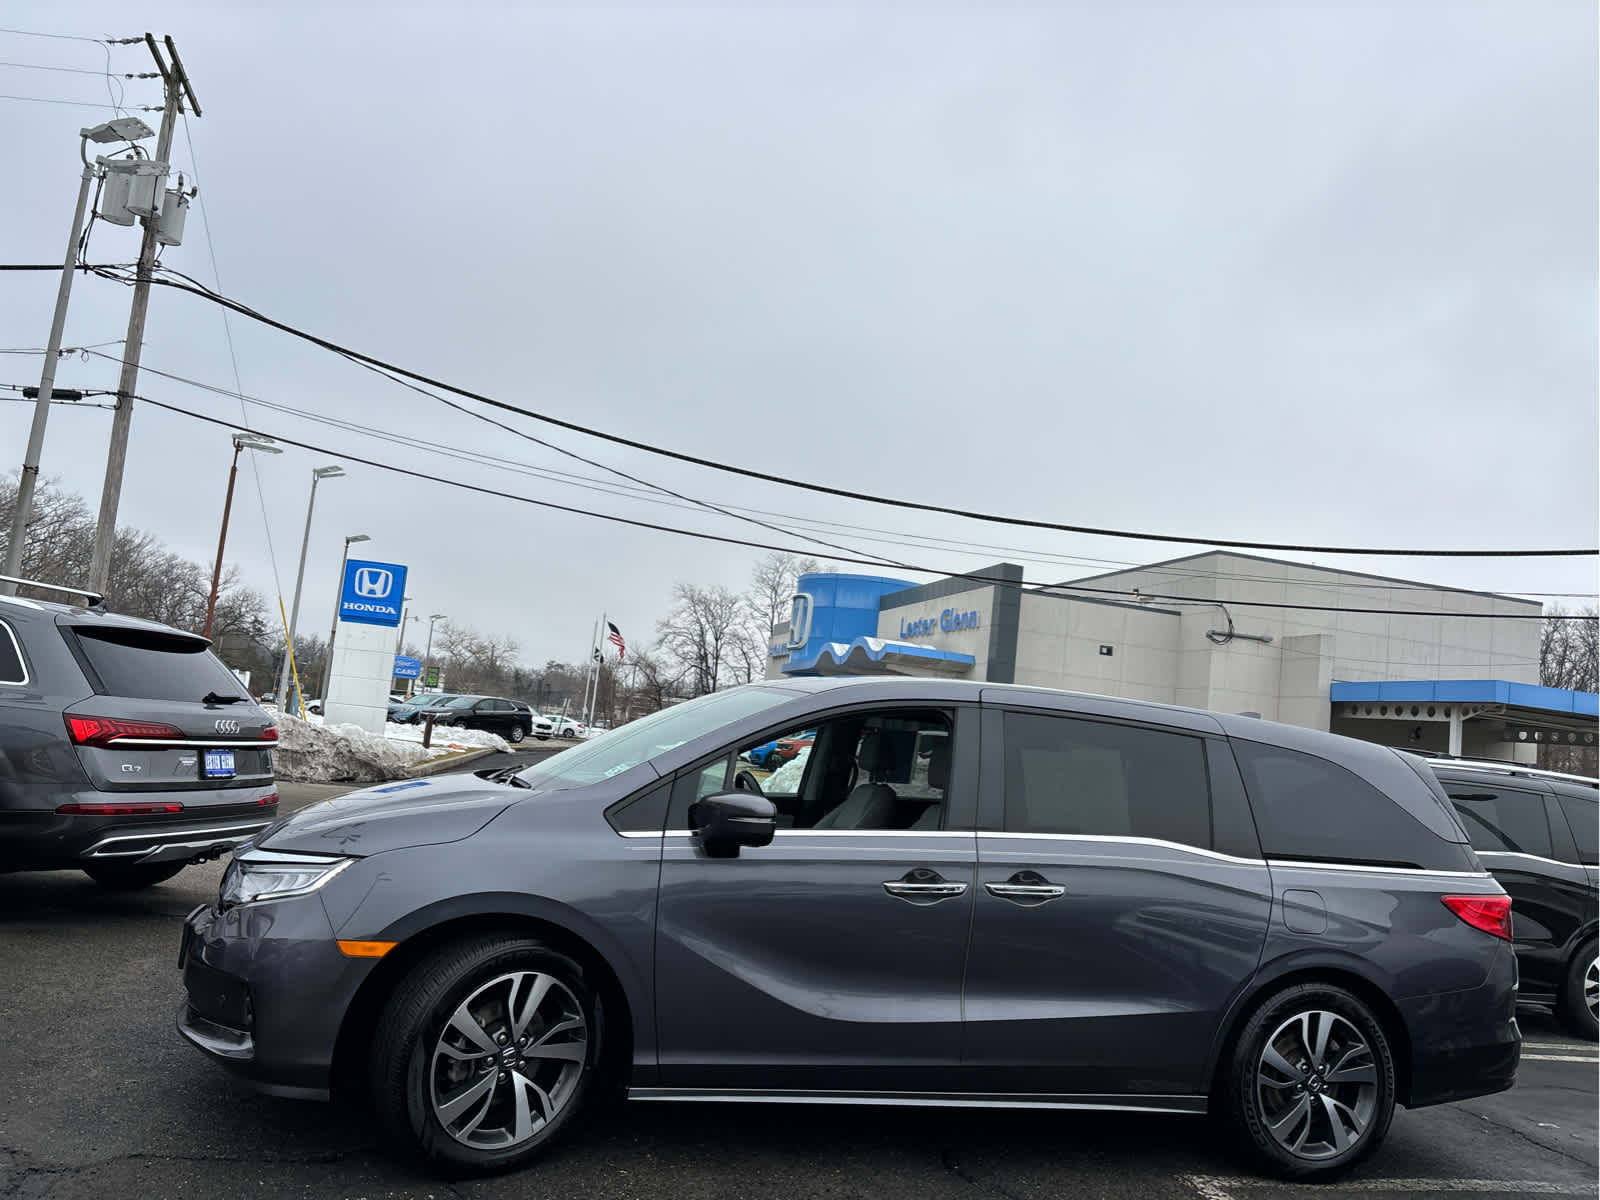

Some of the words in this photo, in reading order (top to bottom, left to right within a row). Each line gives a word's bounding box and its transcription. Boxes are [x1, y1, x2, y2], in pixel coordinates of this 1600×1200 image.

[343, 602, 396, 614] HONDA
[900, 616, 935, 638] Lester
[940, 608, 977, 632] Glenn
[121, 764, 142, 772] Q7
